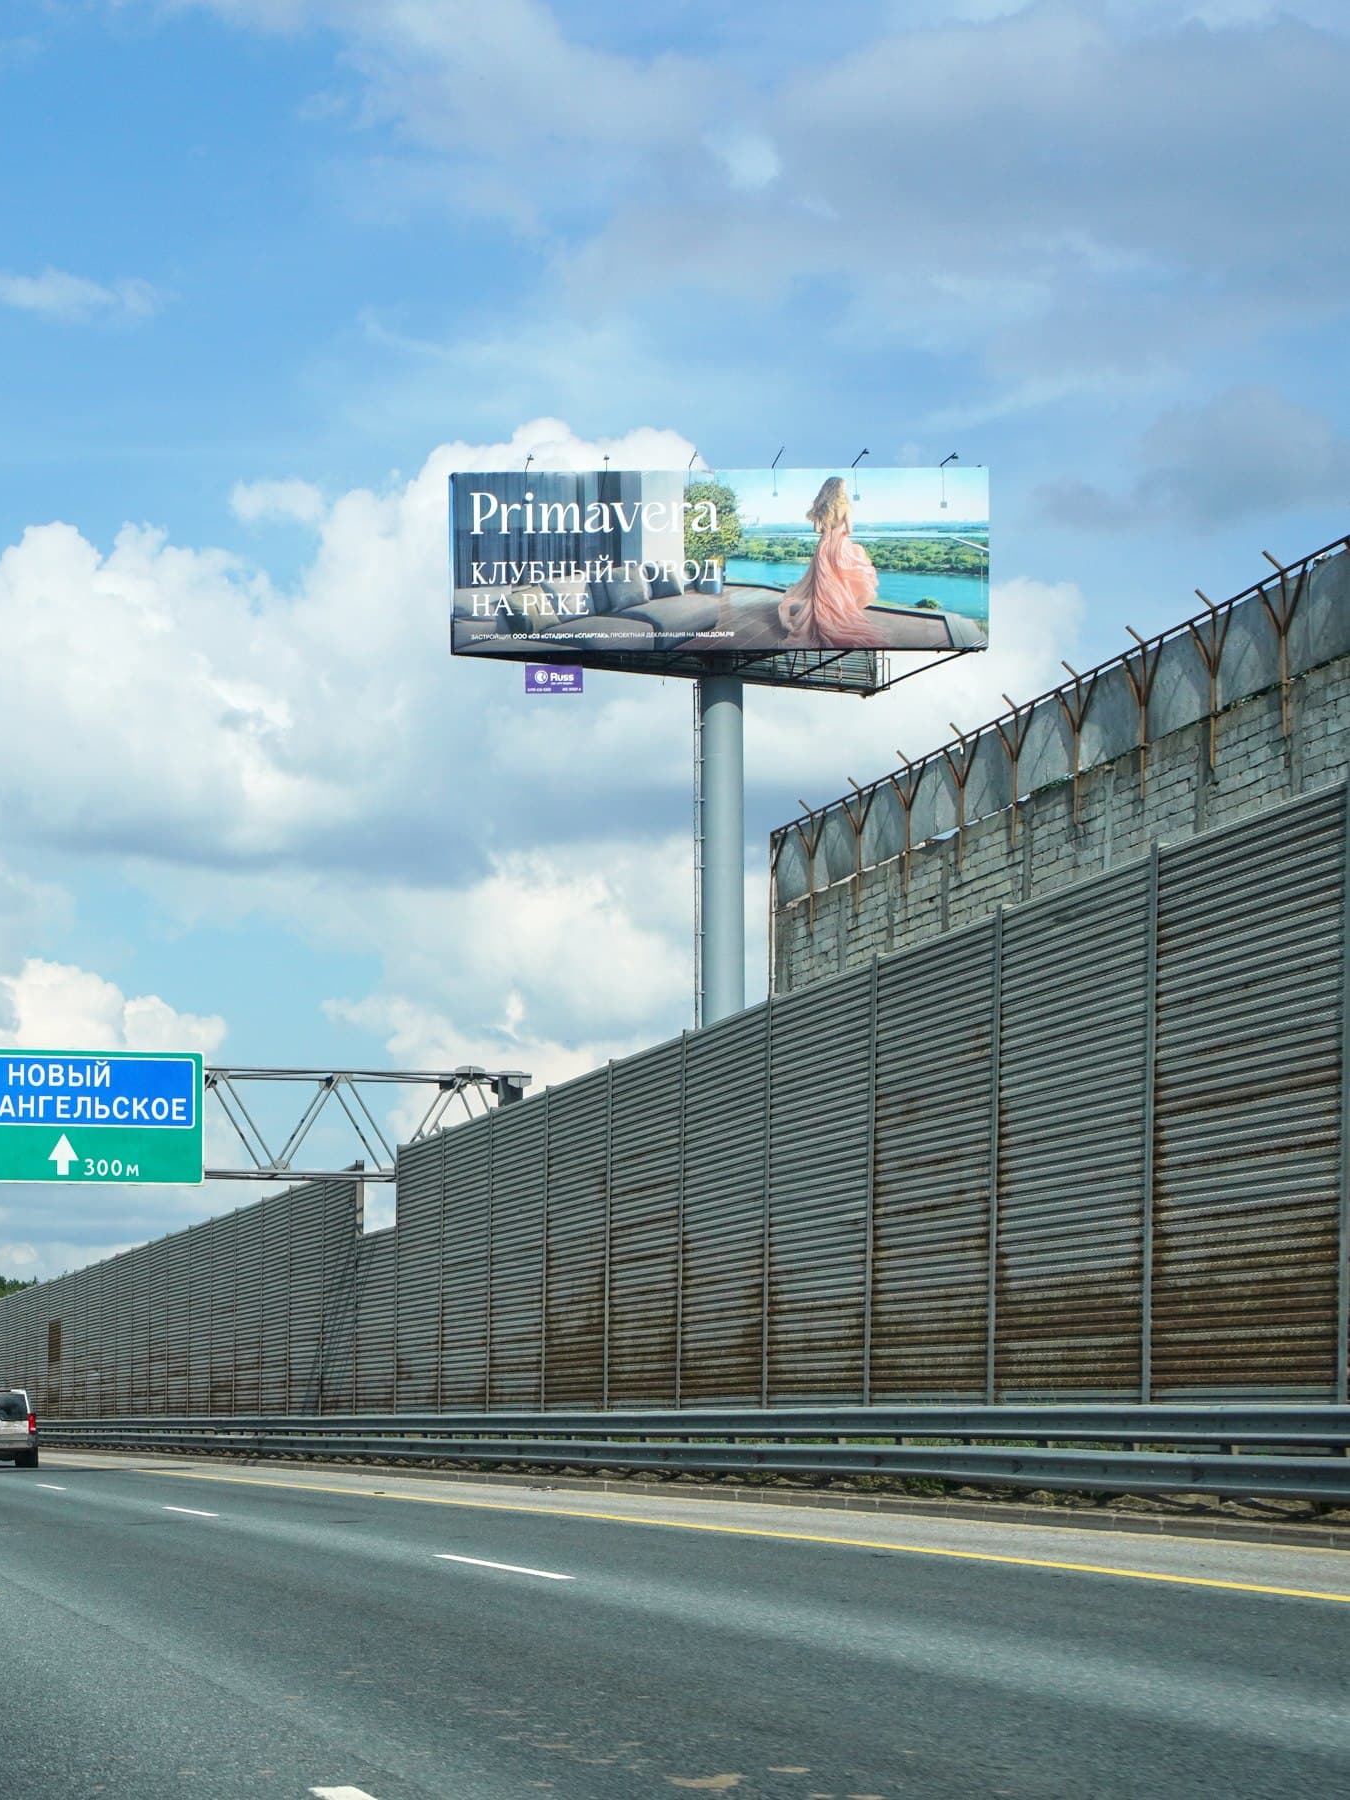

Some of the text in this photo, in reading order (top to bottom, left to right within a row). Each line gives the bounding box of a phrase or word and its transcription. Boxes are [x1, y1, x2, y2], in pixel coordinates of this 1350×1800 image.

[470, 493, 720, 534] Primavera
[471, 555, 720, 584] КЛУБНЫЙ ГОРОД
[471, 593, 590, 616] НА РЕКЕ
[550, 673, 574, 682] Russ
[8, 1061, 111, 1087] НОВЫЙ
